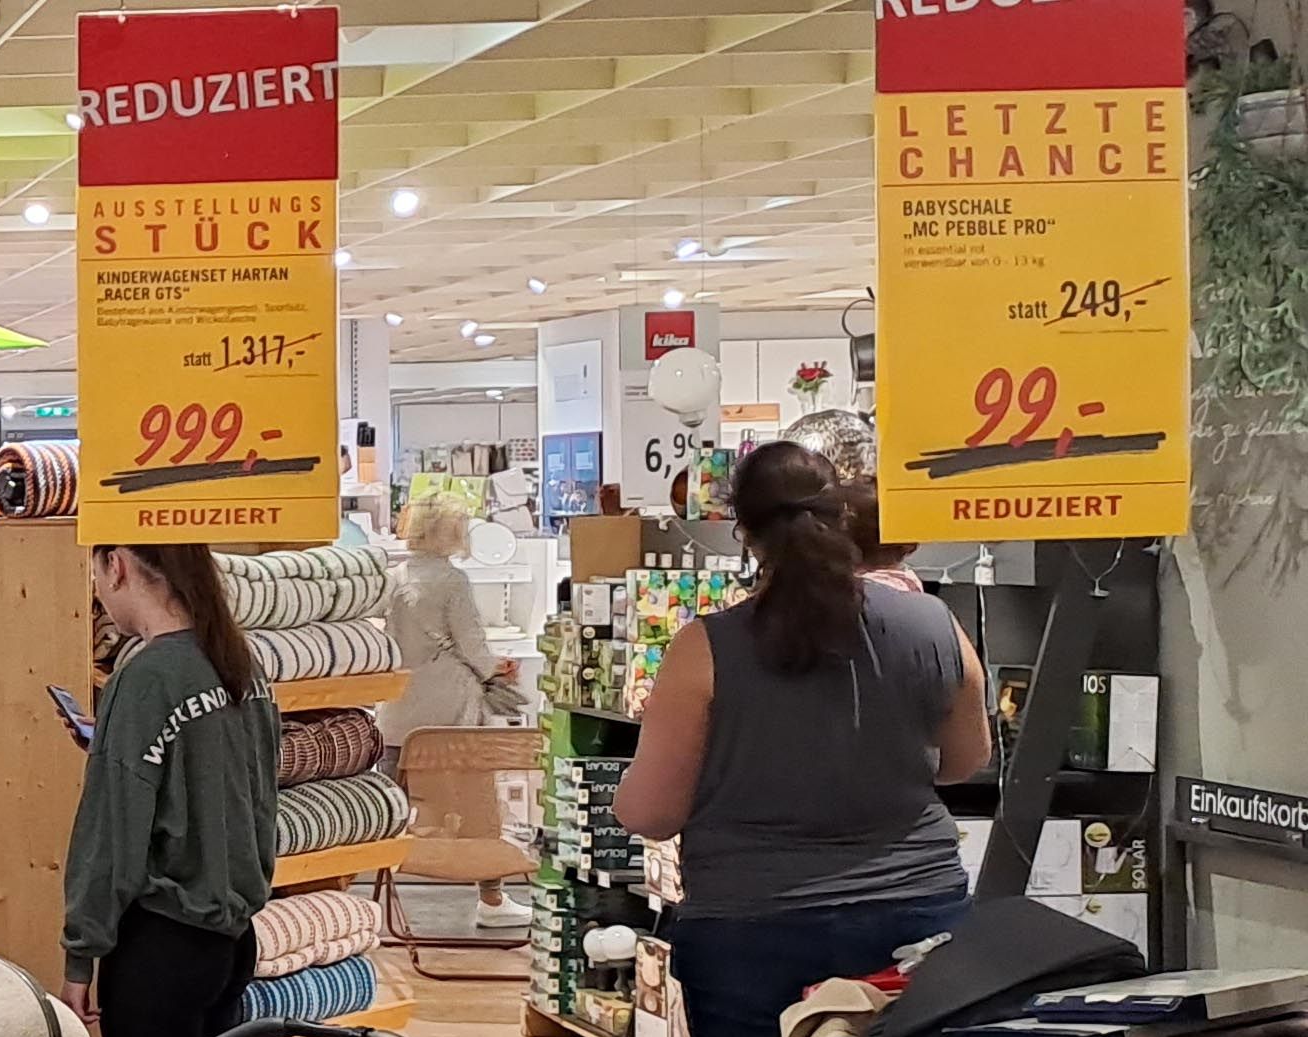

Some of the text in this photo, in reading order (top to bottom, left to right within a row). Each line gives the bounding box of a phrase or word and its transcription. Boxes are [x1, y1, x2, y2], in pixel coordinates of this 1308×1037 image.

[78, 61, 339, 128] REDUZIERT
[899, 101, 1166, 138] LETZTE
[899, 142, 1167, 179] CHANCE
[93, 195, 322, 218] AUSSTELLUNGS
[903, 199, 1012, 216] BABYSCHALE
[95, 216, 322, 255] STÜCK
[946, 219, 1007, 237] PEBBLE
[97, 267, 289, 285] KINDERWAGENSET HARTAN
[1008, 280, 1147, 322] statt 249,-
[183, 353, 212, 367] statt
[964, 366, 1105, 459] 99,-
[134, 402, 283, 472] 999,-
[138, 507, 282, 528] REDUZIERT
[953, 495, 1122, 520] REDUZIERT
[591, 784, 618, 793] OLAR
[590, 805, 614, 815] LAR
[1132, 839, 1147, 890] SOLAR
